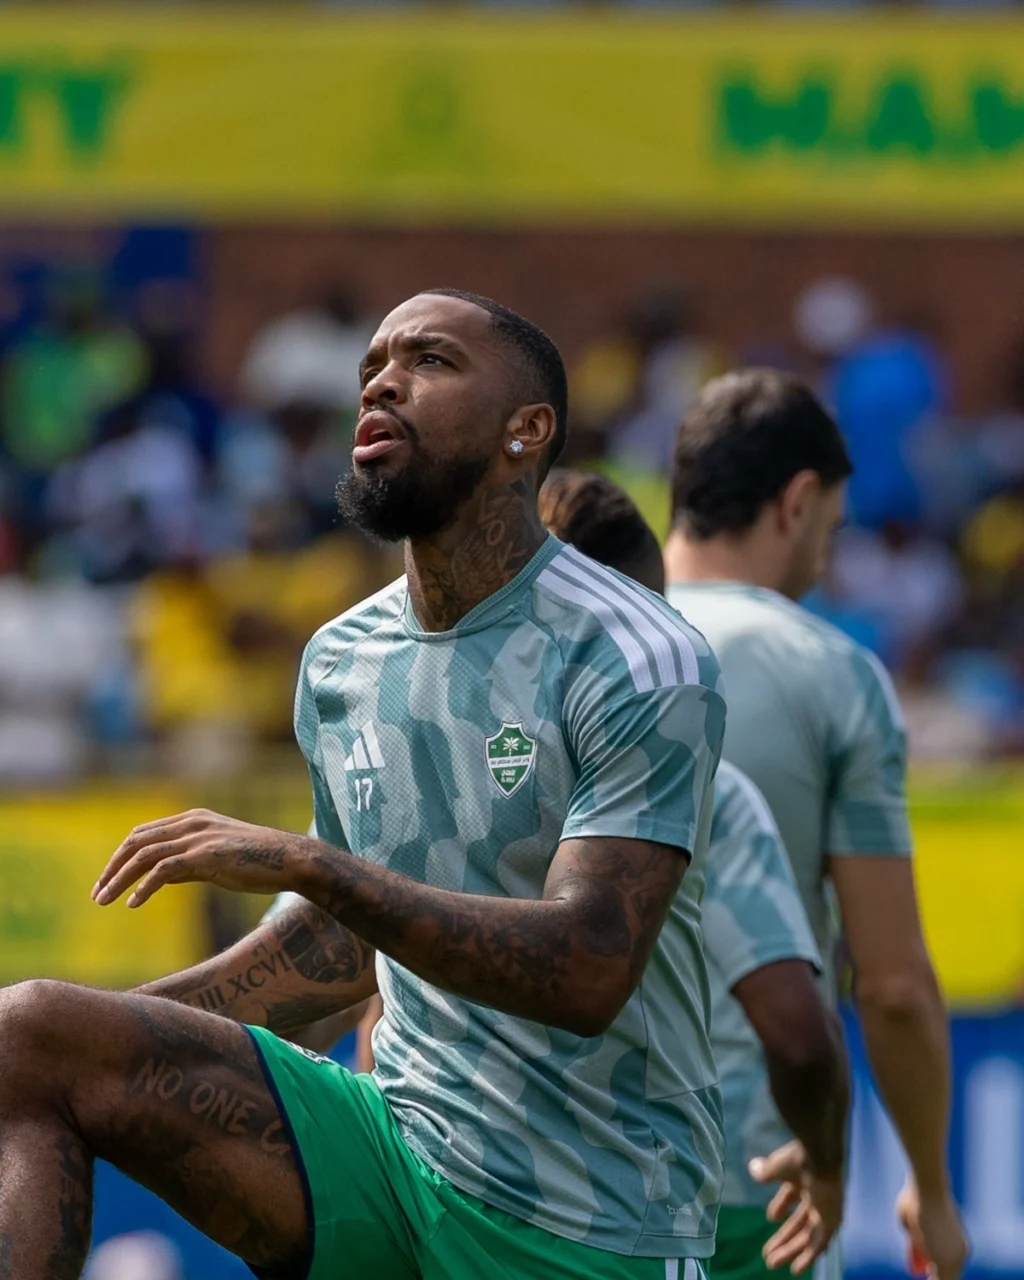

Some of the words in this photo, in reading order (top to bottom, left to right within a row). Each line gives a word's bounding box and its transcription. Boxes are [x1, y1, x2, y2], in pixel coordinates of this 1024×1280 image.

[354, 777, 373, 811] 17
[129, 1057, 184, 1101] NO
[189, 1080, 260, 1135] ONE
